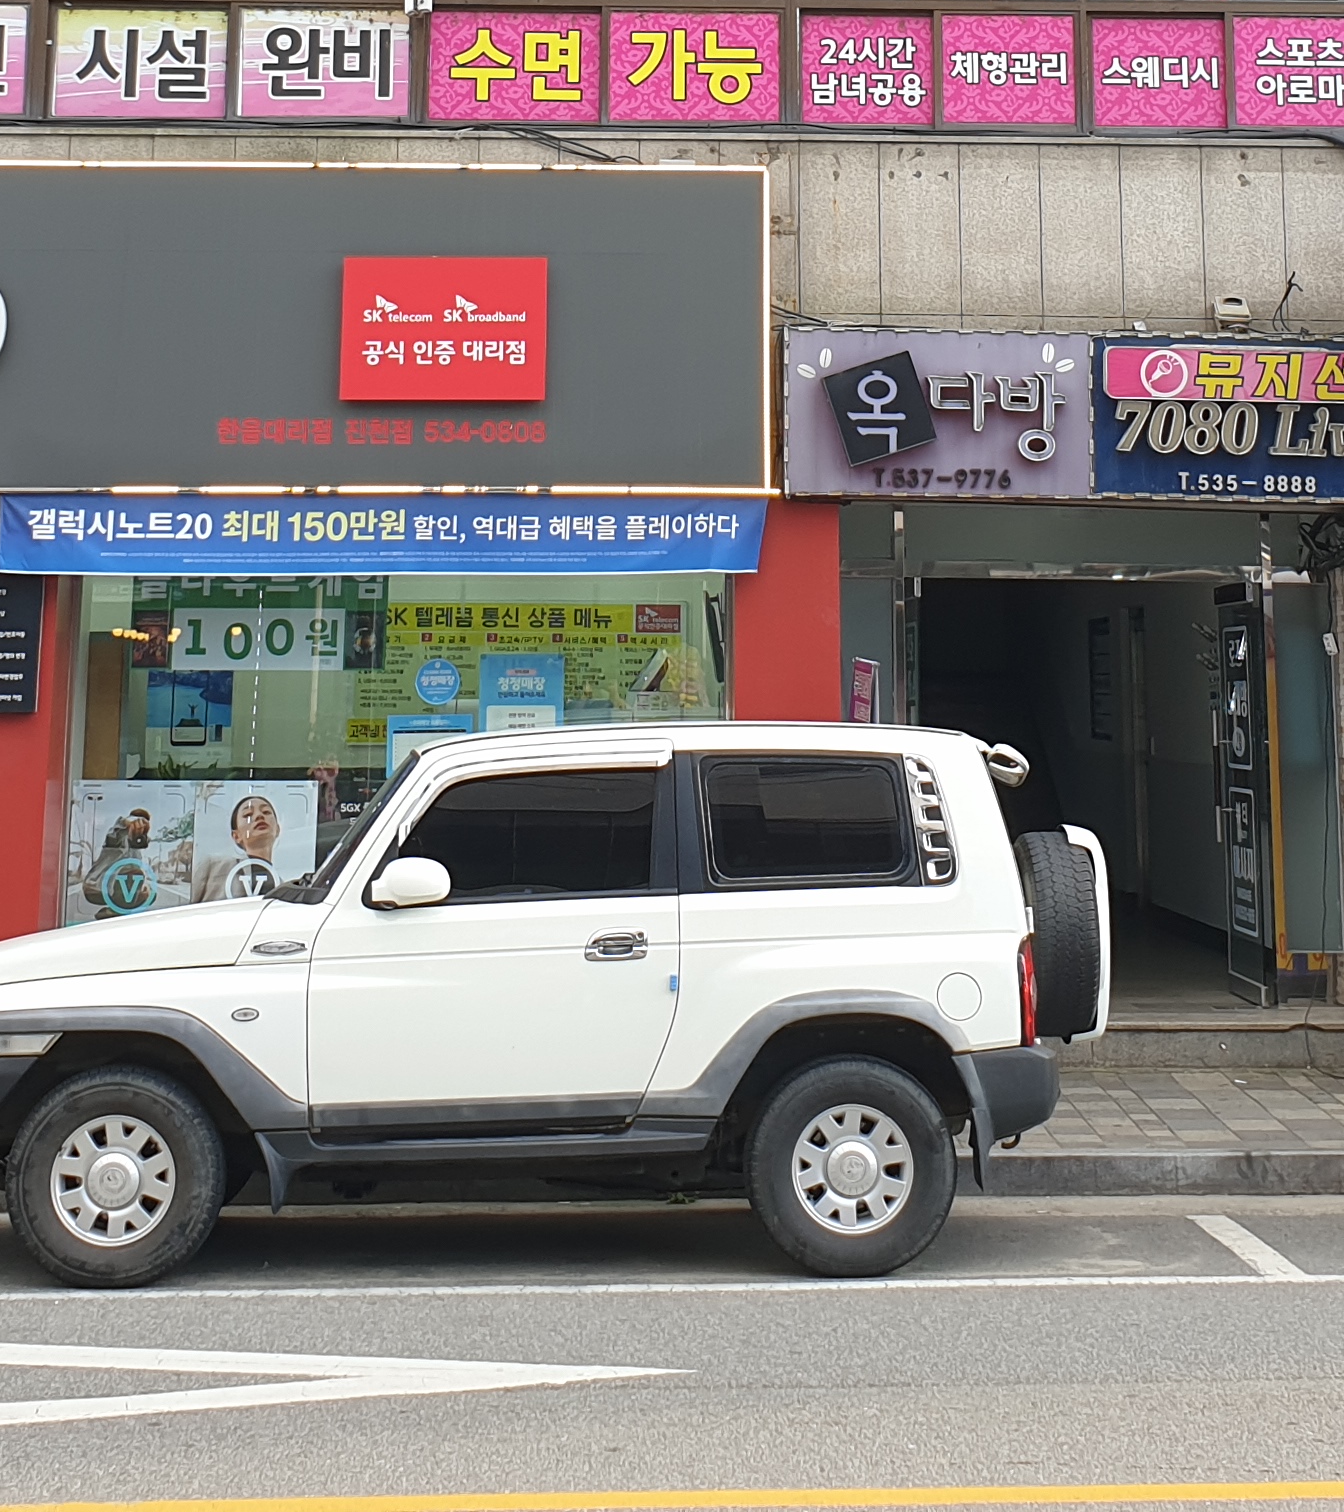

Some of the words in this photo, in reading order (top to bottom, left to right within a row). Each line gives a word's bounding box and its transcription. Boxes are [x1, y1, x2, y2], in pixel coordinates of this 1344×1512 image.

[74, 27, 210, 102] 시설
[259, 25, 395, 101] 완비
[449, 28, 583, 103] 수면
[627, 28, 763, 106] 가능
[819, 37, 917, 71] 24시간
[949, 51, 1069, 87] 체형관리
[1101, 56, 1220, 90] 스웨디시
[811, 74, 927, 108] 남녀공용
[363, 308, 383, 323] SK
[388, 311, 433, 323] telecom
[443, 308, 463, 323] SK
[467, 310, 526, 323] broadband
[362, 341, 405, 365] 공식
[412, 341, 456, 365] 인증
[462, 340, 527, 365] 대리점
[424, 419, 547, 445] 534-0808
[1114, 401, 1260, 456] 7080
[872, 468, 1012, 488] T.537-9776
[28, 508, 213, 543] 갤럭시노트20
[221, 509, 280, 543] 최대
[288, 508, 407, 544] 150만원
[413, 514, 467, 544] 할인,
[472, 514, 542, 543] 역대급
[549, 512, 618, 542] 혜택을
[625, 511, 740, 541] 플레이하다
[415, 606, 474, 629] 텔레콤
[481, 606, 519, 629] 통신
[527, 607, 566, 630] 상품
[573, 607, 613, 630] 메뉴
[497, 676, 547, 691] 청정매장
[340, 803, 361, 812] 5GX
